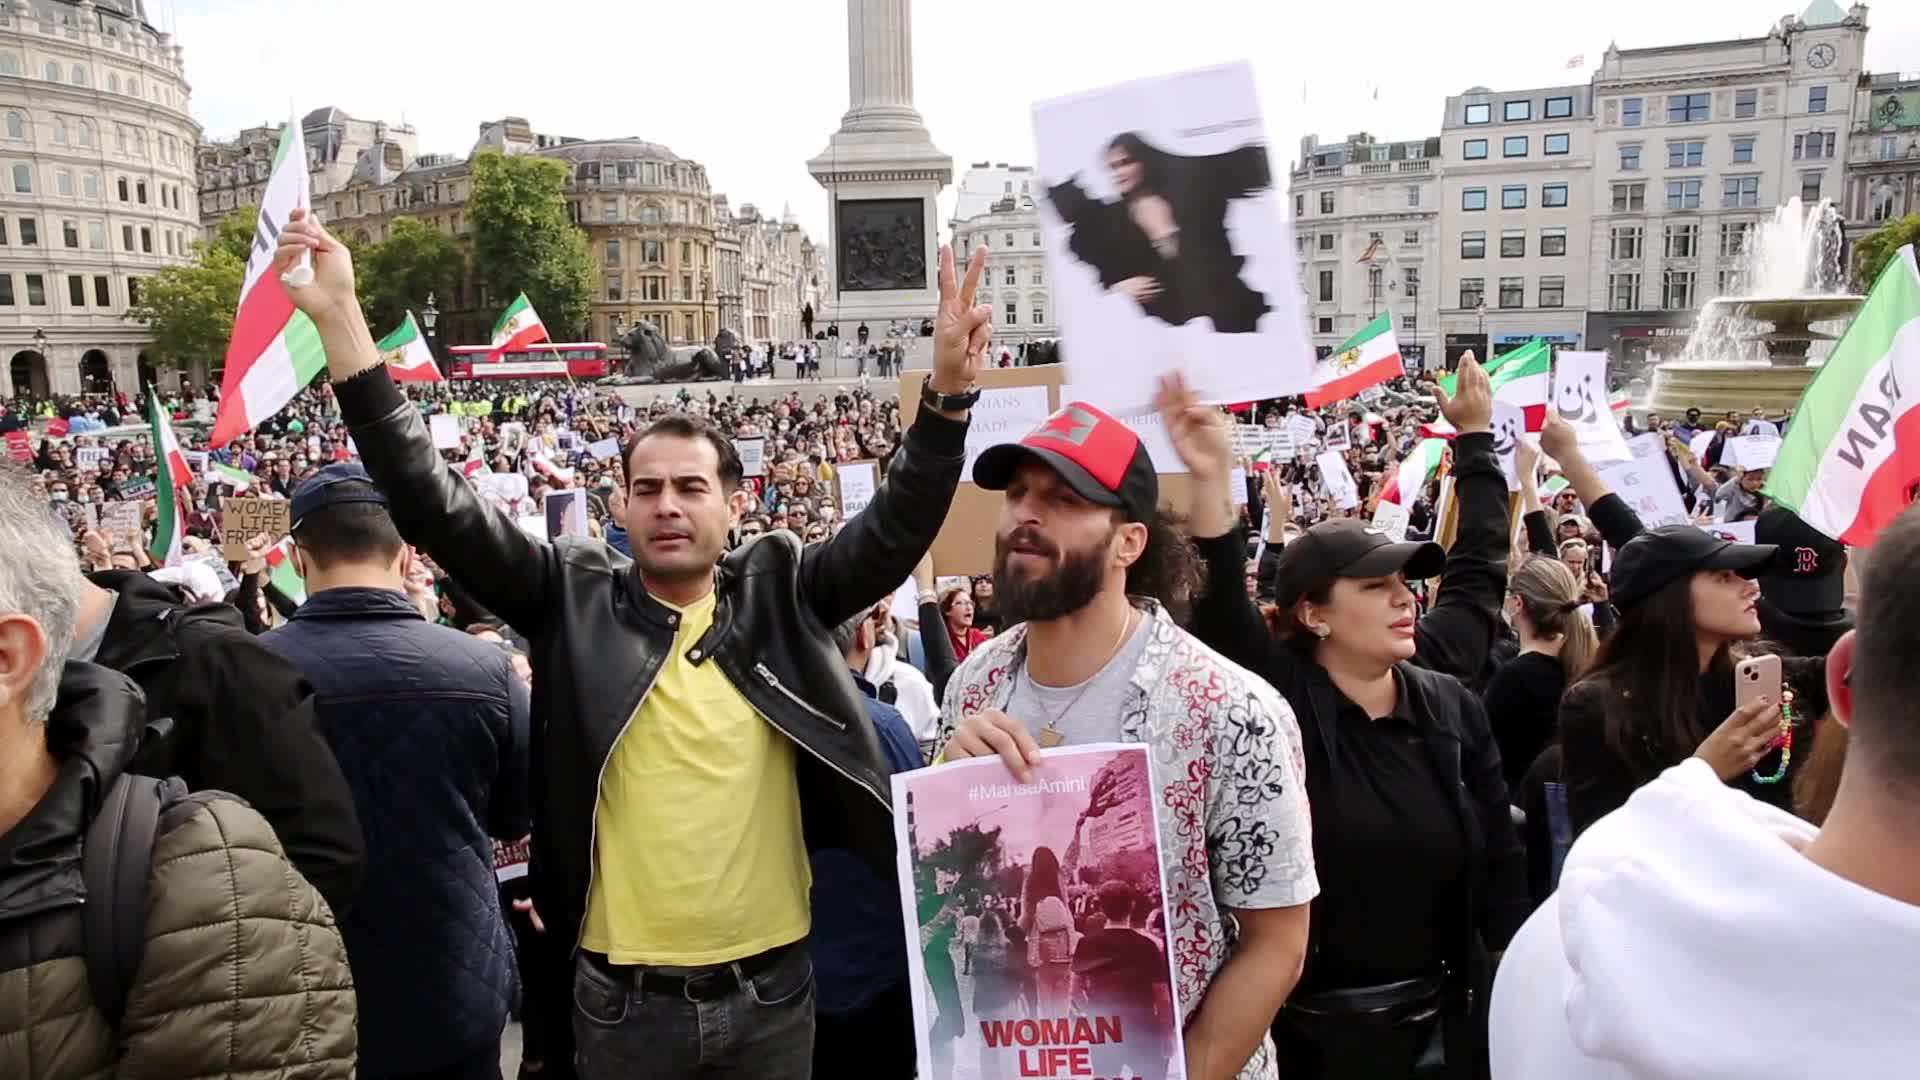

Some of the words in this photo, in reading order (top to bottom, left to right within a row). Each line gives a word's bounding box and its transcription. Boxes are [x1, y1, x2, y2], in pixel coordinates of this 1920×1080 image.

[976, 397, 1022, 409] NIANS
[240, 515, 281, 531] LIFE
[980, 1015, 1124, 1049] WOMAN
[1018, 1048, 1092, 1077] LIFE
